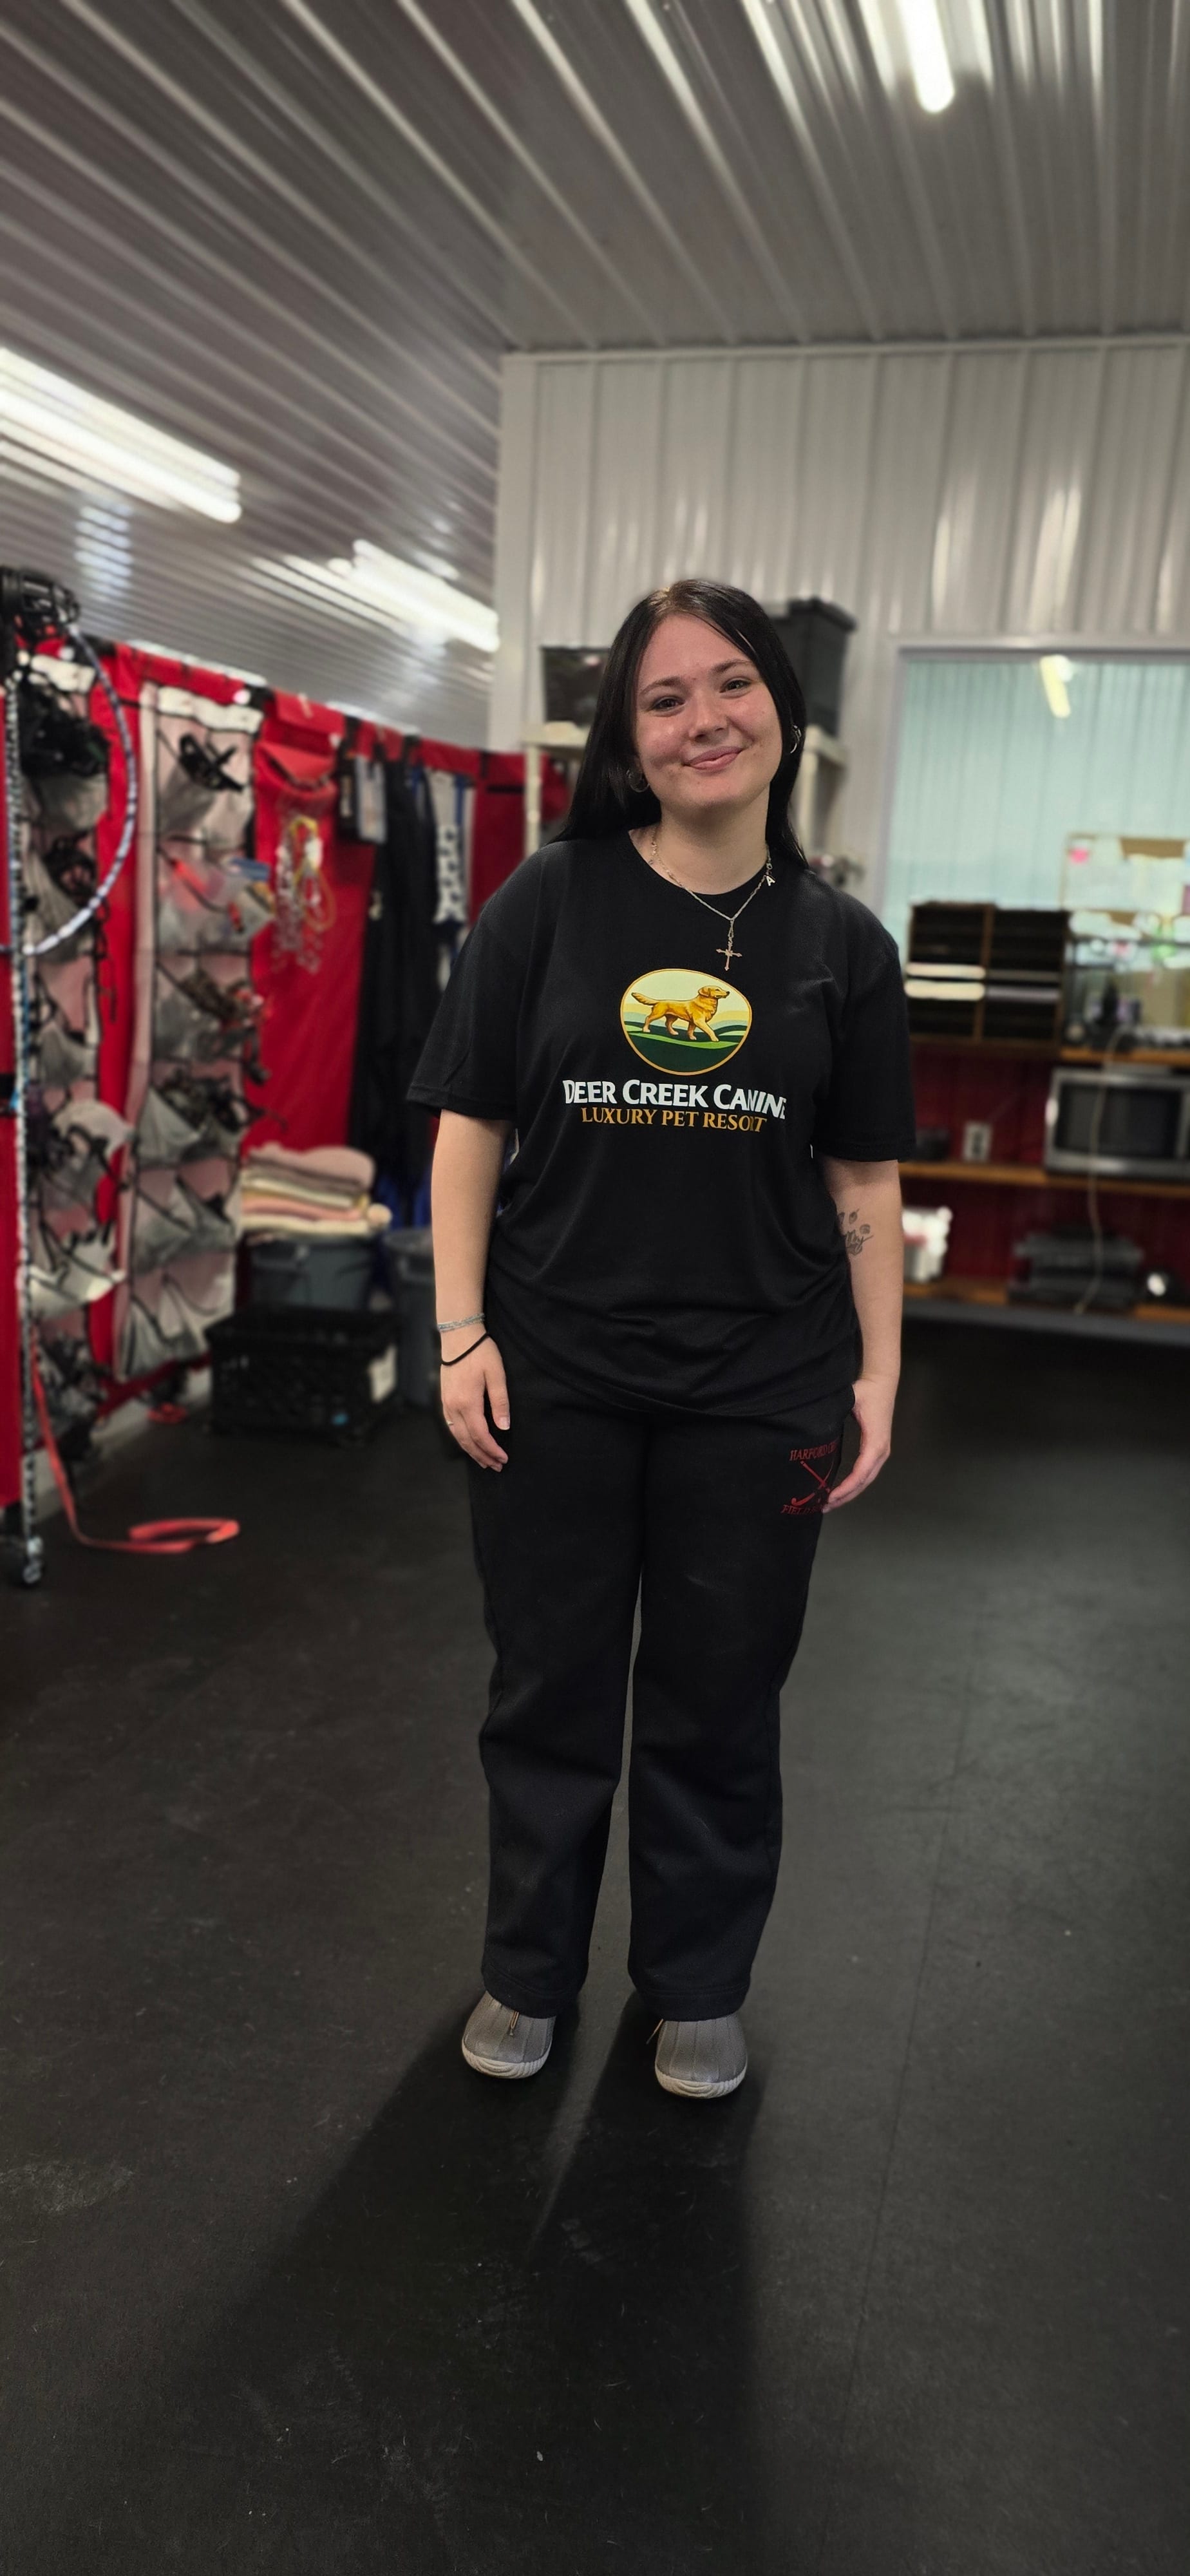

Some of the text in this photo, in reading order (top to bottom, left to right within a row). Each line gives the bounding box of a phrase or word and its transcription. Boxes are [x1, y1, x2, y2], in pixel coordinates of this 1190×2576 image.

[562, 1079, 617, 1104] DEER
[622, 1079, 710, 1107] CREEK
[581, 1107, 658, 1124] LUXURY
[662, 1110, 701, 1127] PET
